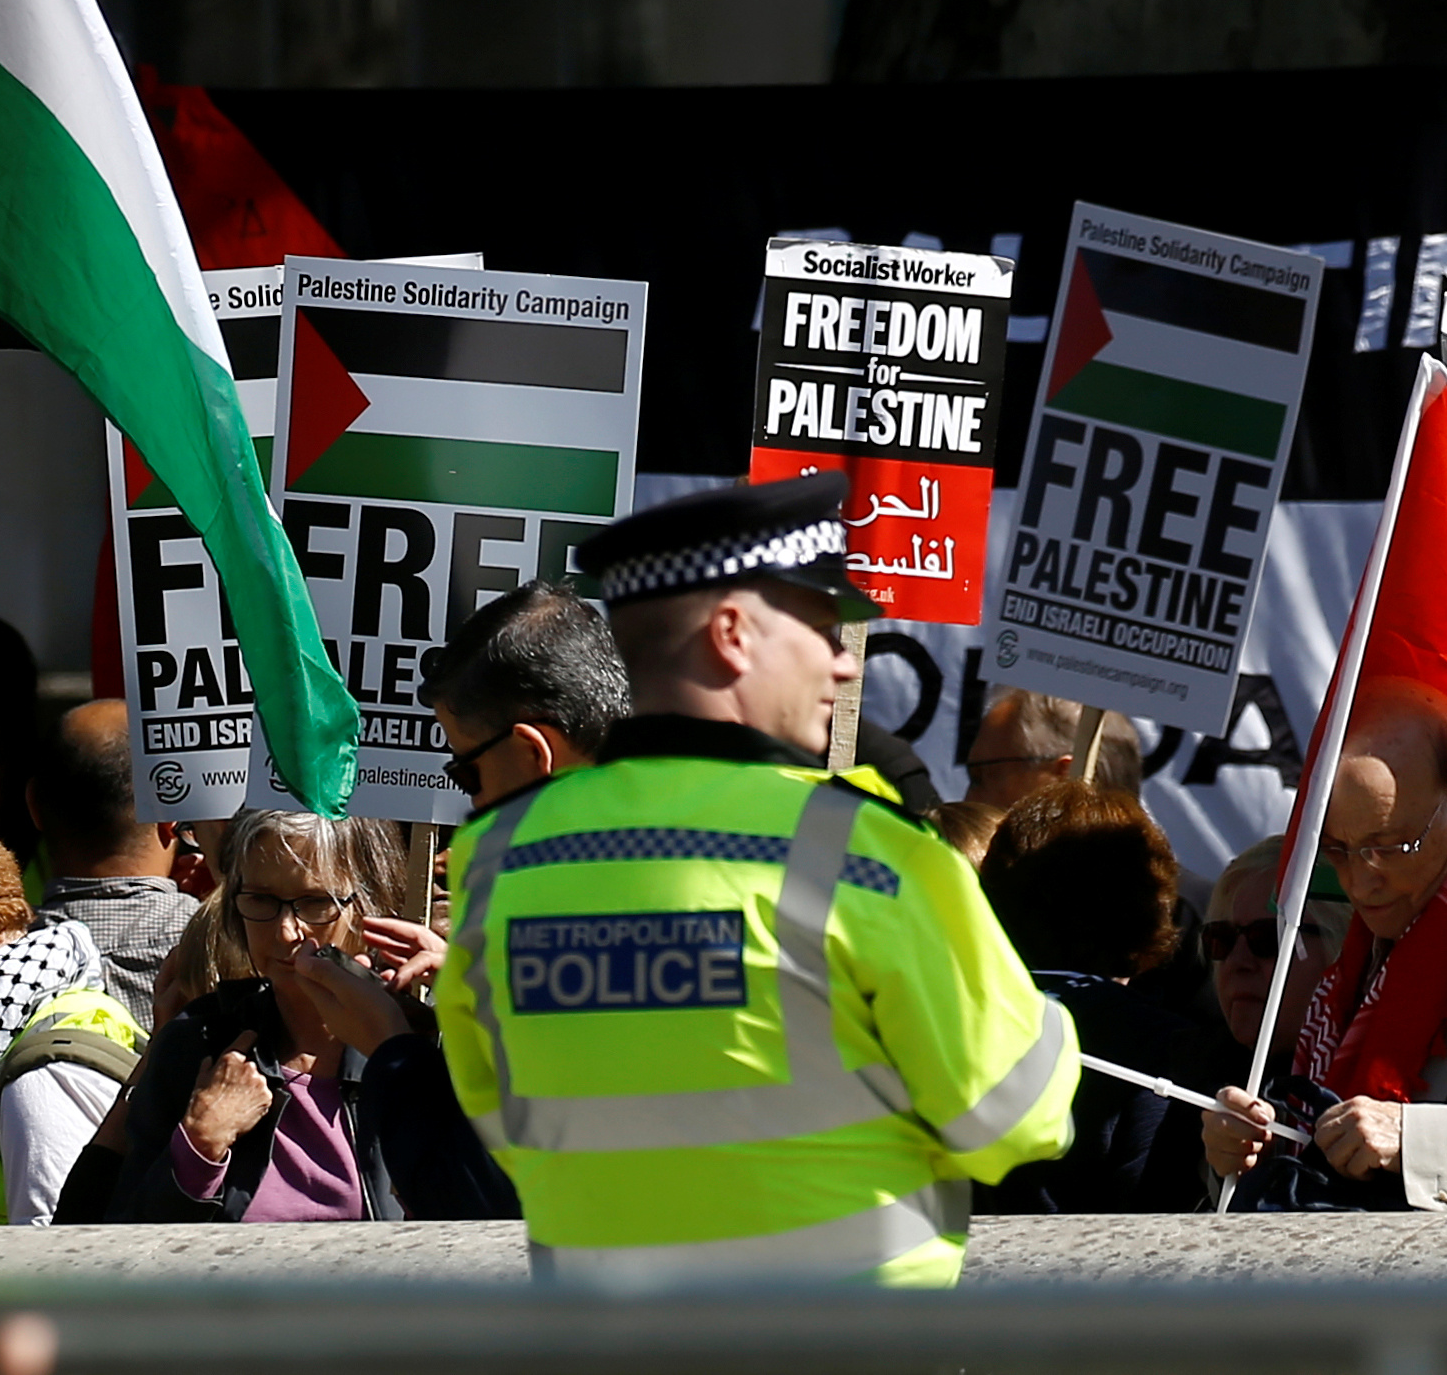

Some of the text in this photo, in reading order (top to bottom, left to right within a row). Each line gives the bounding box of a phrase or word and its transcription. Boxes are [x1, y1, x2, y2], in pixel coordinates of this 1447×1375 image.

[1080, 219, 1310, 293] Palestine Solidarity Campaign
[228, 283, 284, 310] Solid
[297, 273, 629, 323] Palestine Solidarity Campaign
[783, 291, 983, 364] FREEDOM
[867, 356, 902, 386] for
[766, 379, 987, 453] PALESTINE
[1020, 414, 1272, 580] FREE
[1008, 530, 1246, 637] PALESTINE
[1003, 595, 1231, 672] END ISRAELI OCCUPATION
[147, 721, 201, 750] END
[510, 918, 740, 950] METROPOLITAN
[512, 949, 742, 1007] POLICE
